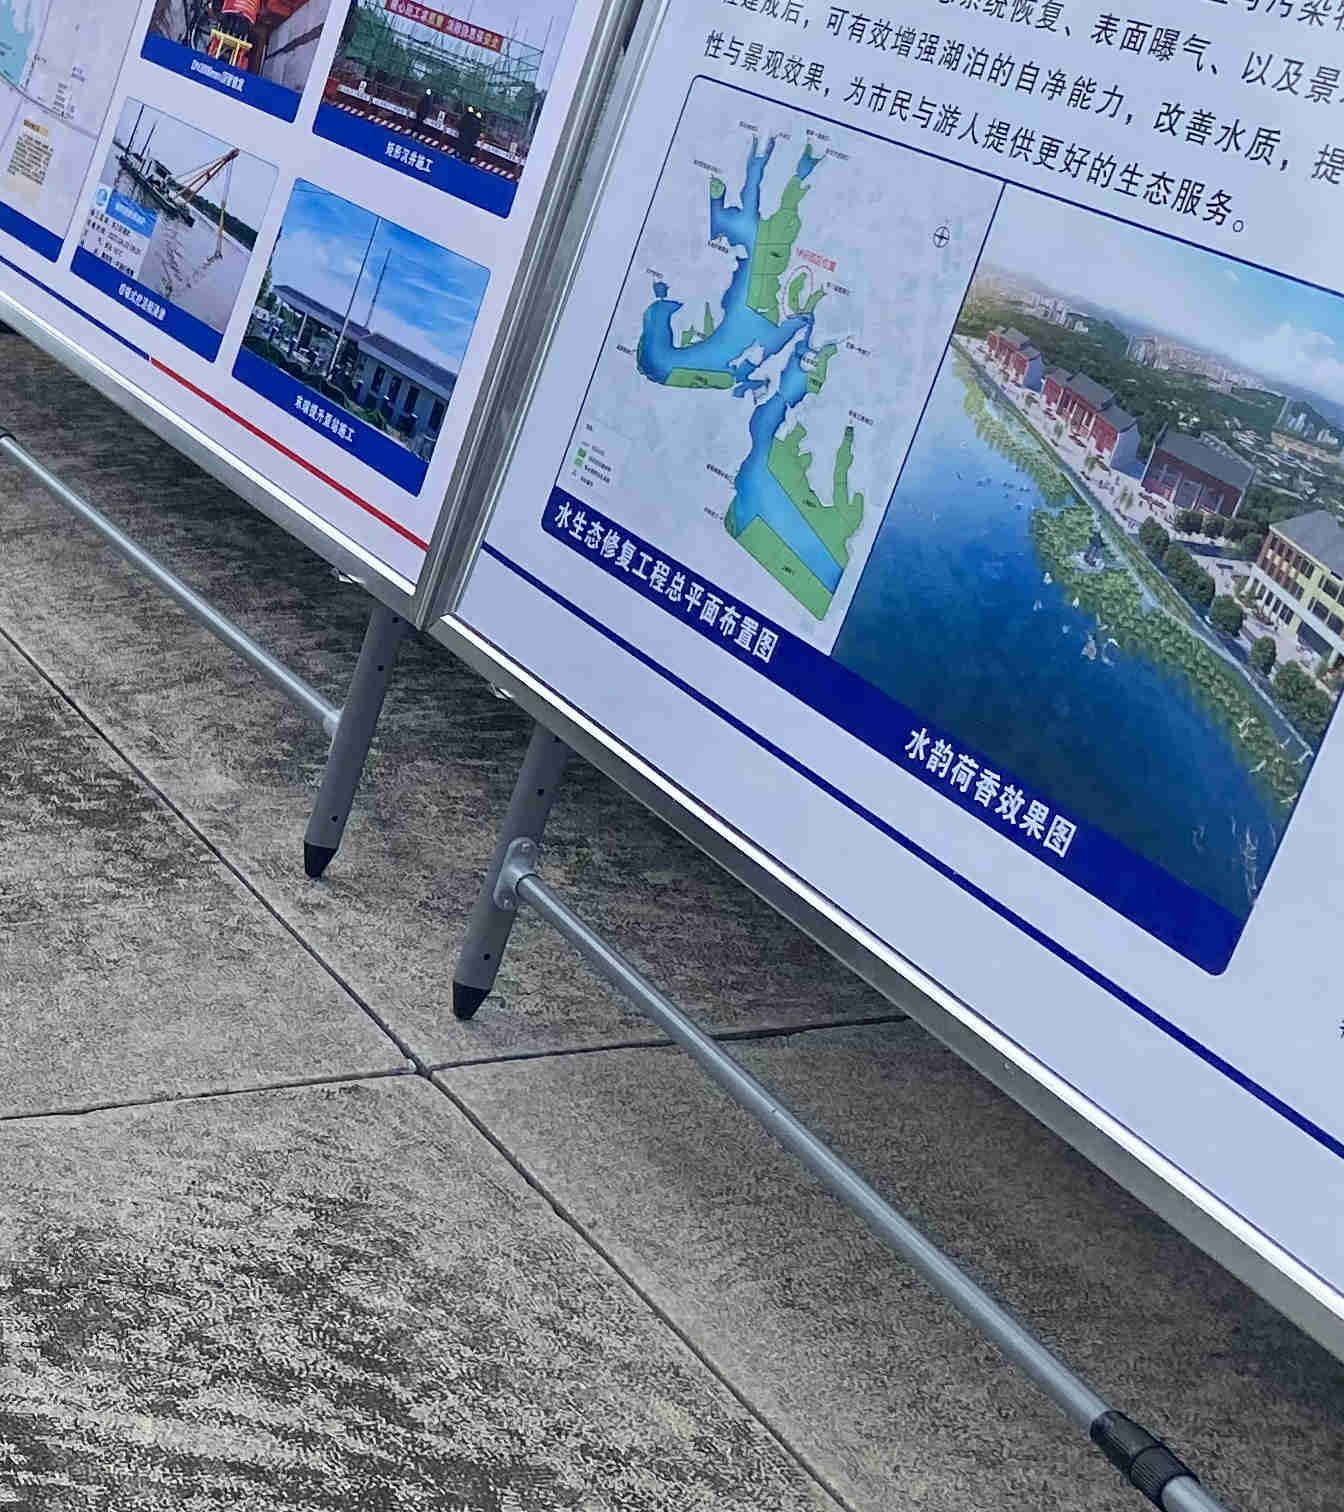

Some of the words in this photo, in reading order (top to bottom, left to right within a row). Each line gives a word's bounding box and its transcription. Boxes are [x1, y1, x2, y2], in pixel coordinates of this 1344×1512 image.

[554, 501, 779, 664] 水生态修复工程总平面布置图
[904, 727, 1078, 858] 水韵荷香效果图
